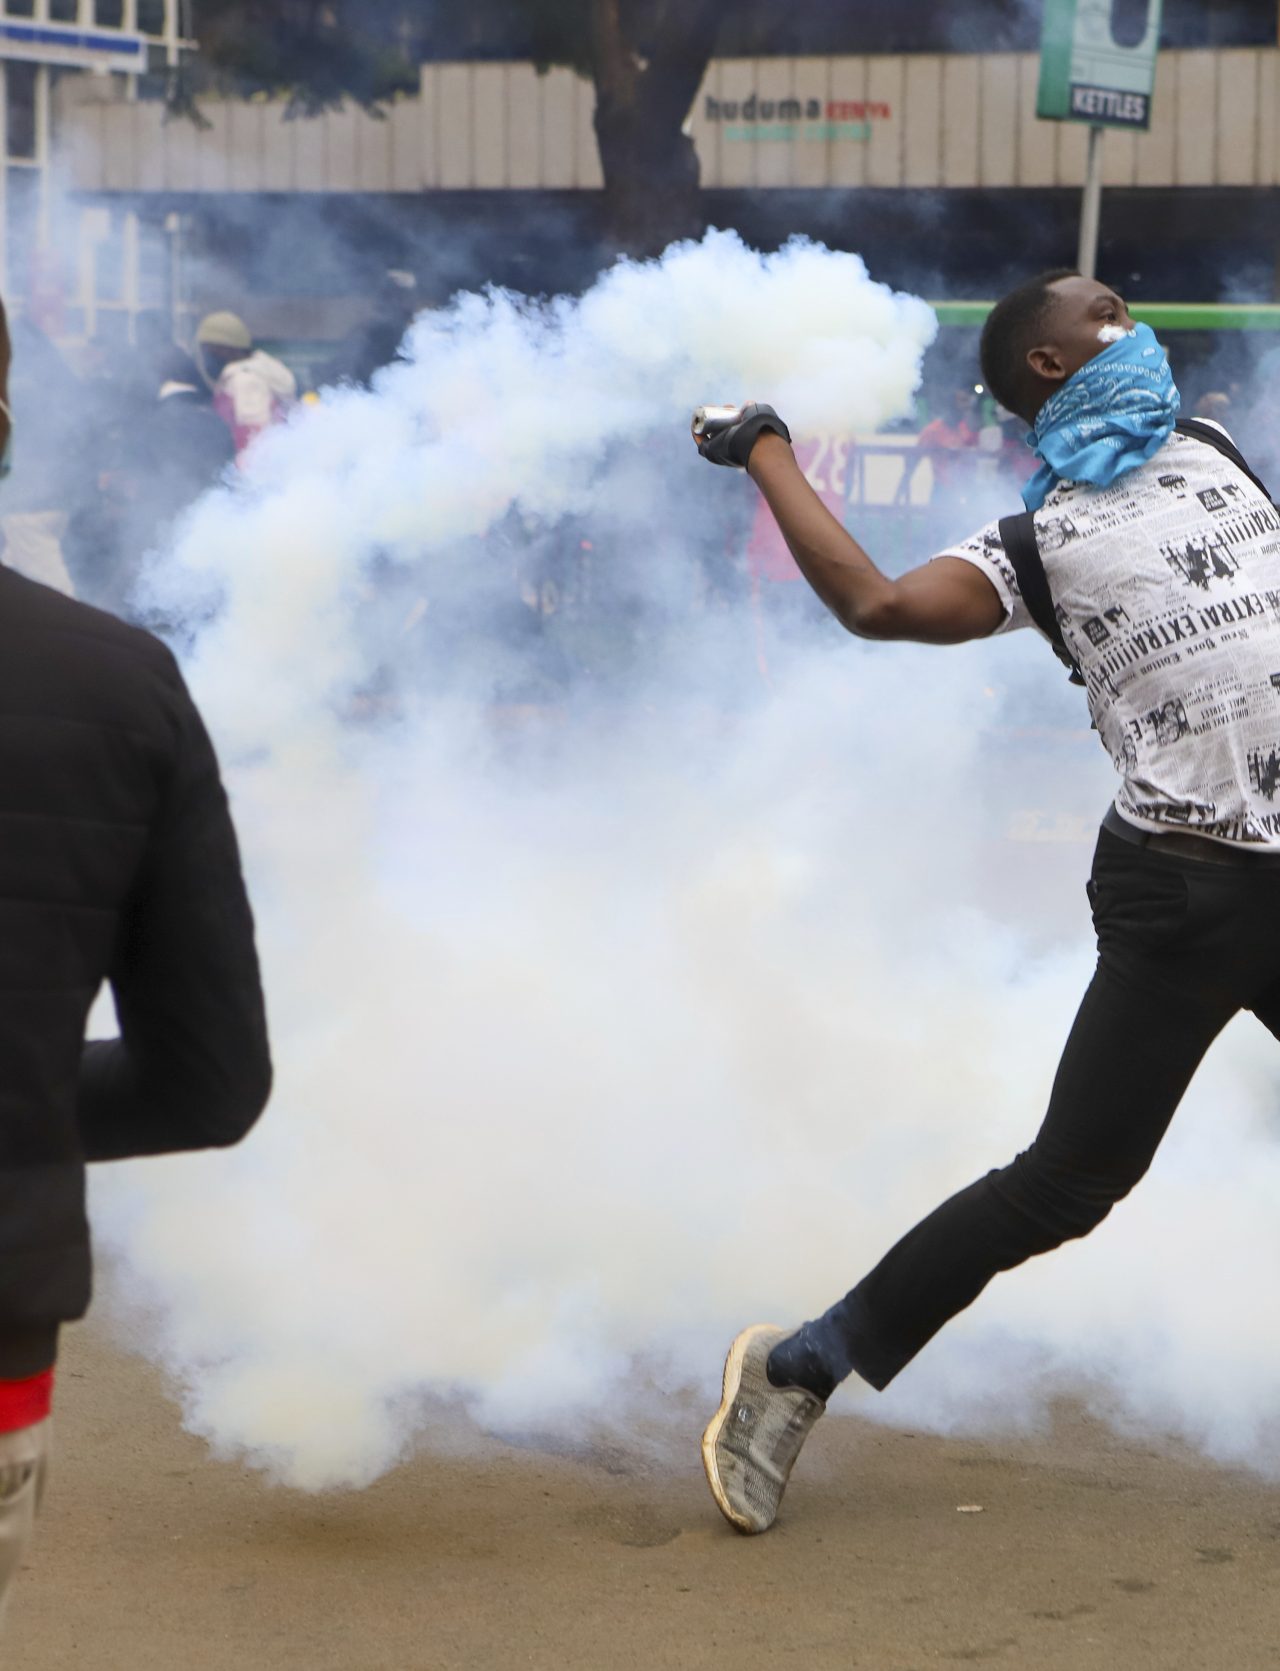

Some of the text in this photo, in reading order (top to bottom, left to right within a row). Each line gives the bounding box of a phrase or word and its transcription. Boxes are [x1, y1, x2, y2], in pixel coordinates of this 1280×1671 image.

[705, 94, 820, 121] huduma
[1073, 88, 1145, 120] KETTLES
[1197, 593, 1266, 631] EXTRA!
[1220, 628, 1250, 643] New
